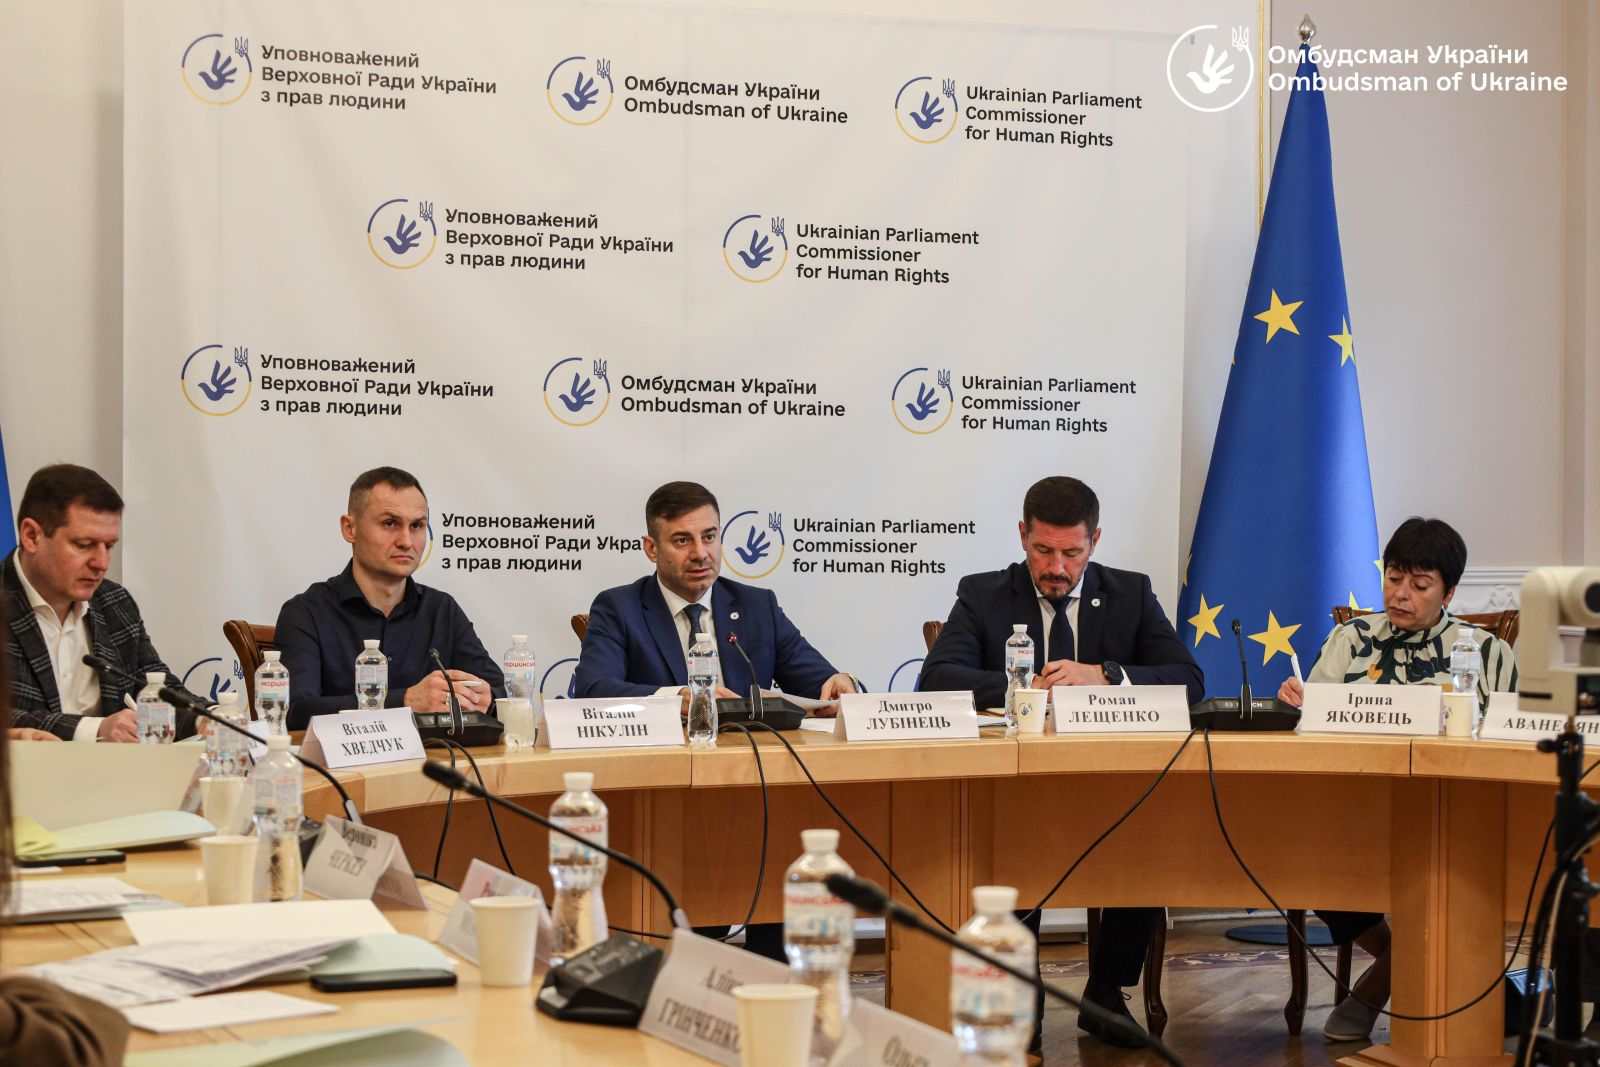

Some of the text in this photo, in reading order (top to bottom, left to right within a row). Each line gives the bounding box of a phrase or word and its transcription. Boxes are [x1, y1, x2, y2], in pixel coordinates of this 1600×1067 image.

[261, 44, 419, 69] Уповноважений
[261, 66, 497, 95] Верховної Ради України
[624, 75, 820, 102] Омбудсман України
[260, 90, 406, 111] з прав людини
[966, 85, 1143, 110] Ukrainian Parliament
[624, 97, 849, 124] Ombudsman of Ukraine
[965, 105, 1087, 126] Commissioner
[964, 125, 1114, 149] for Human Rights
[445, 208, 598, 229] Уповноважений
[446, 229, 674, 255] Верховної Ради України
[796, 223, 980, 245] Ukrainian Parliament
[444, 252, 586, 271] з прав людини
[796, 243, 922, 263] Commissioner
[795, 263, 950, 286] for Human Rights
[260, 353, 416, 375] Уповноважений
[261, 375, 494, 400] Верховної Ради України
[621, 374, 817, 398] Омбудсман України
[962, 375, 1137, 395] Ukrainian Parliament
[260, 399, 402, 417] з прав людини
[620, 396, 846, 417] Ombudsman of Ukraine
[961, 395, 1081, 412] Commissioner
[960, 414, 1108, 435] for Human Rights
[441, 512, 595, 530] Уповноважений
[793, 517, 976, 535] Ukrainian Parliament
[442, 533, 644, 554] Верховної Ради Укра
[792, 538, 918, 554] Commissioner
[441, 557, 582, 573] з прав людини
[791, 557, 946, 577] for Human Rights
[878, 700, 933, 714] Дмитро
[1088, 694, 1136, 705] Роман
[1348, 692, 1393, 708] Ірина
[866, 716, 951, 731] ЛУБІНЕЦЬ
[1068, 710, 1160, 724] ЛЕЩЕНКО
[1326, 710, 1412, 726] ЯКОВЕЦЬ
[342, 720, 388, 736] Віталій
[576, 724, 649, 738] НІКУЛІН
[341, 737, 404, 757] ХВЕДЧУК
[657, 997, 742, 1055] ГРІНЧЕНК
